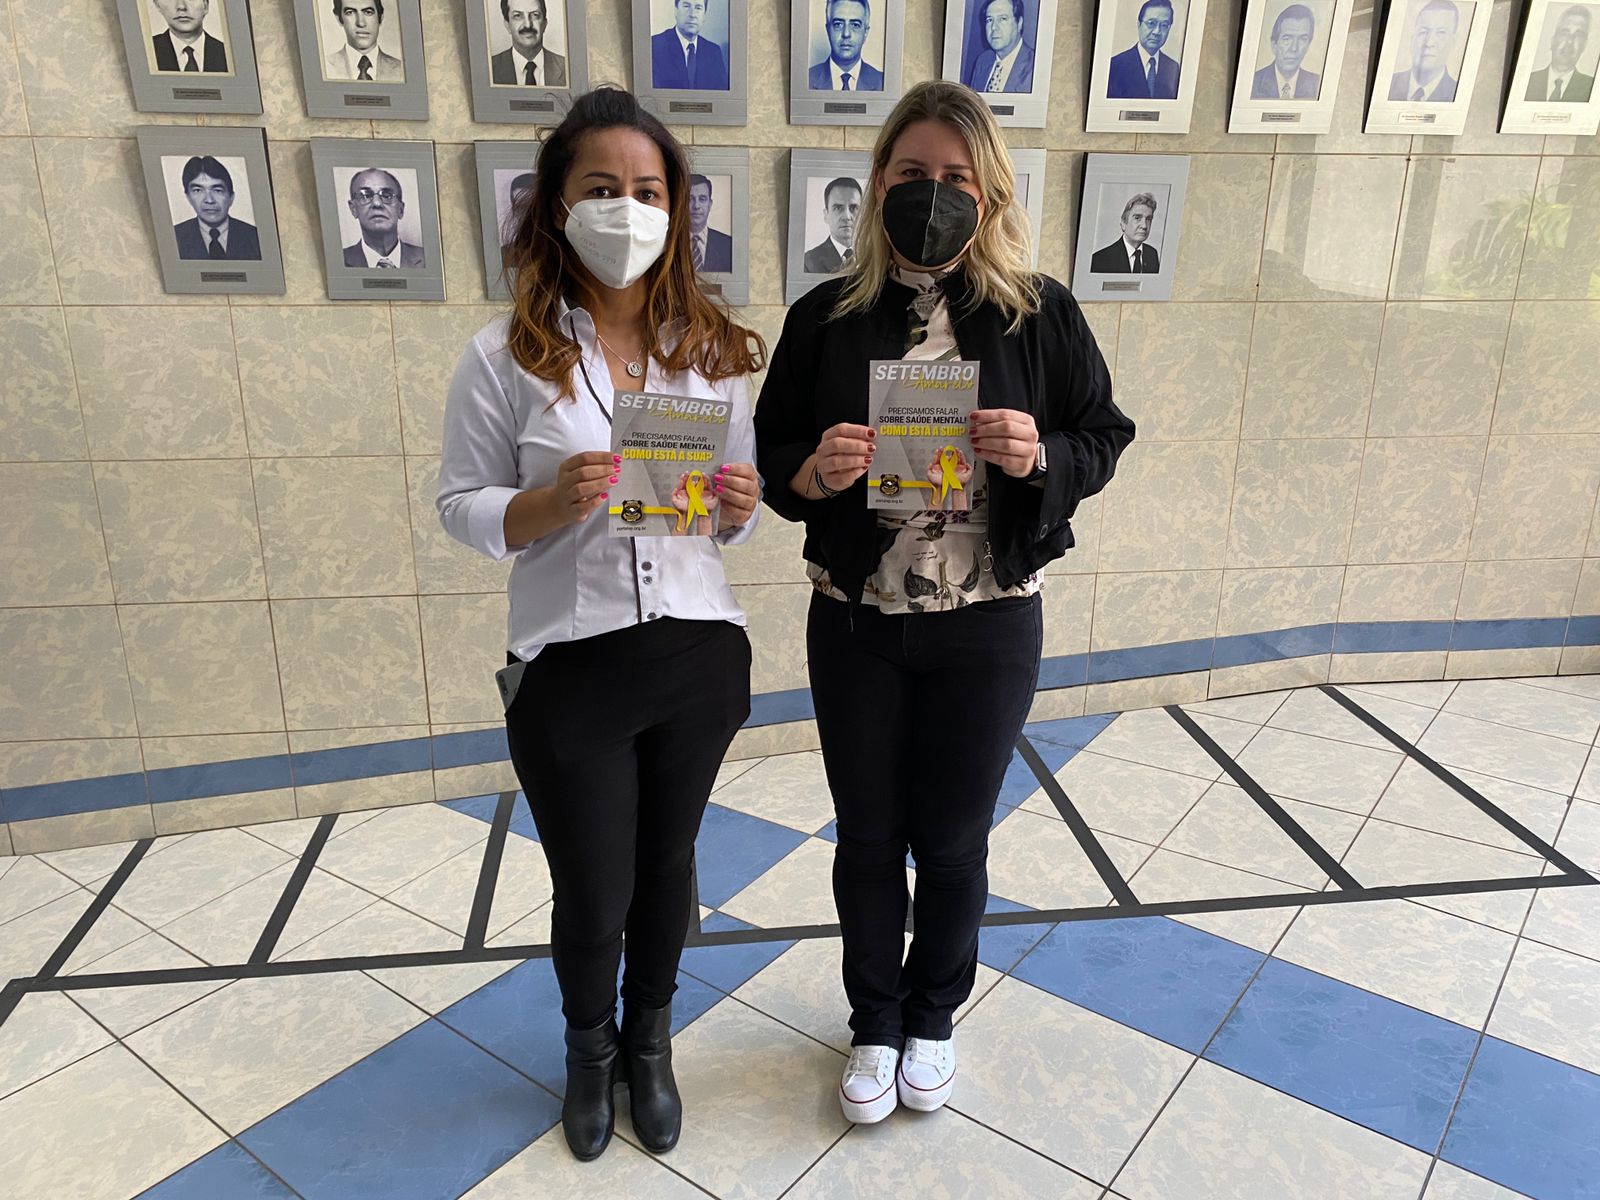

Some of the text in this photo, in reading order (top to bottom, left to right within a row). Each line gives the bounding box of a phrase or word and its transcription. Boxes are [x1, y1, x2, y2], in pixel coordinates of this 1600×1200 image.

[875, 364, 974, 380] SETEMBRO
[619, 394, 728, 416] SETEMBRO
[888, 407, 960, 415] PRECISAMOS FALAR
[878, 413, 967, 424] SOBRE SAÚDE MENTAL!
[879, 424, 907, 436] COMO
[932, 425, 939, 436] A
[631, 431, 708, 442] PRECISAMOS FALAR
[621, 439, 715, 451] SOBRE SAÚDE MENTAL!
[622, 448, 652, 460] COMO
[679, 450, 686, 461] A
[687, 451, 713, 462] SUA?
